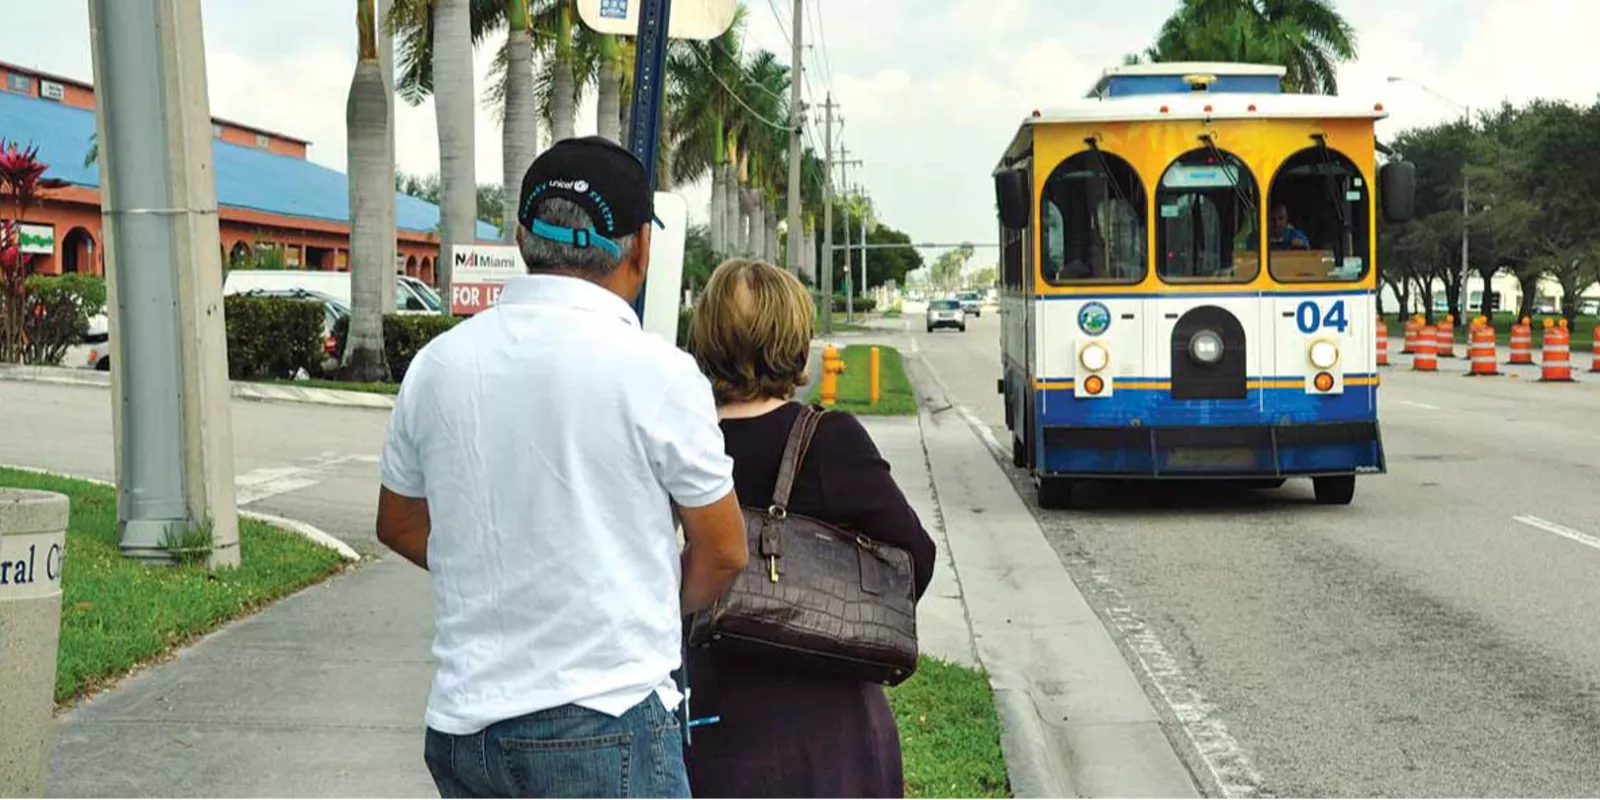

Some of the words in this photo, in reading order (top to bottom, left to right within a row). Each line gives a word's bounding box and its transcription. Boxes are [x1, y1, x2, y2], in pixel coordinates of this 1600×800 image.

[455, 250, 478, 267] NAI
[480, 256, 515, 268] Miami
[452, 286, 480, 307] FOR
[1296, 300, 1348, 333] 04
